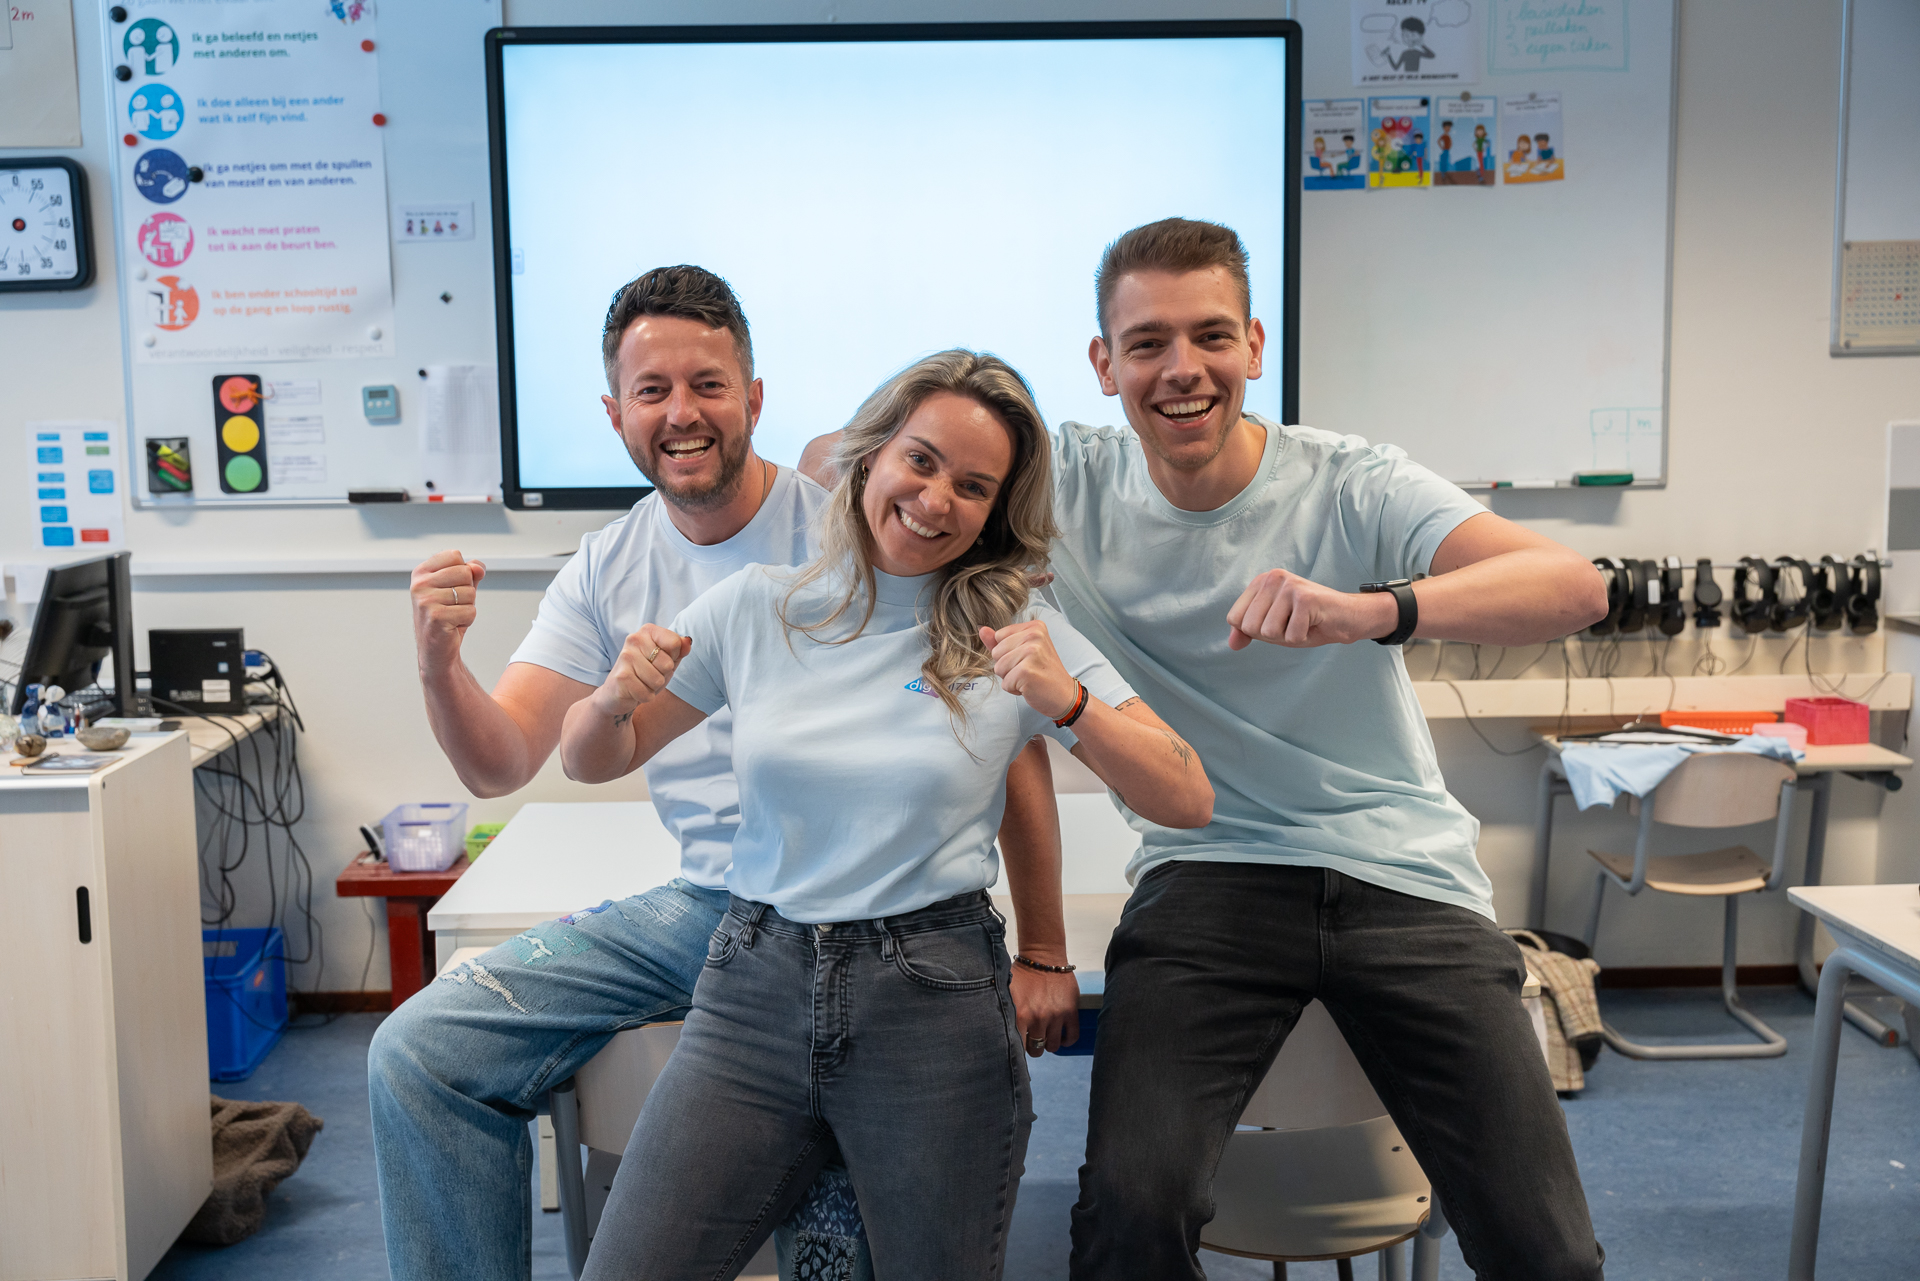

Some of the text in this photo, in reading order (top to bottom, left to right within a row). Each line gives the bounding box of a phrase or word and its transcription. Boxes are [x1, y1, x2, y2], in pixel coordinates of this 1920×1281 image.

[192, 31, 318, 45] Ik ga beleefd en netjes
[194, 47, 290, 59] met anderen om.
[198, 96, 344, 110] Ik doe alleen bij een ander
[198, 112, 308, 125] wat ik zelf fijn vind.
[217, 164, 230, 176] ga
[232, 162, 266, 174] netjes
[269, 163, 288, 171] om
[290, 162, 312, 170] met
[315, 160, 329, 170] de
[332, 160, 372, 172] spullen
[12, 174, 19, 187] 0
[31, 178, 44, 191] 55
[205, 180, 225, 188] van
[228, 178, 265, 188] mezelf
[284, 178, 304, 186] van
[308, 176, 357, 186] anderen.
[50, 194, 62, 206] 50
[58, 217, 71, 229] 45
[208, 225, 320, 238] Ik wacht met praten
[54, 239, 67, 251] 40
[208, 240, 338, 252] tot ik aan de beurt ben.
[18, 262, 31, 276] 30
[40, 257, 54, 269] 35
[910, 680, 978, 692] digijzer
